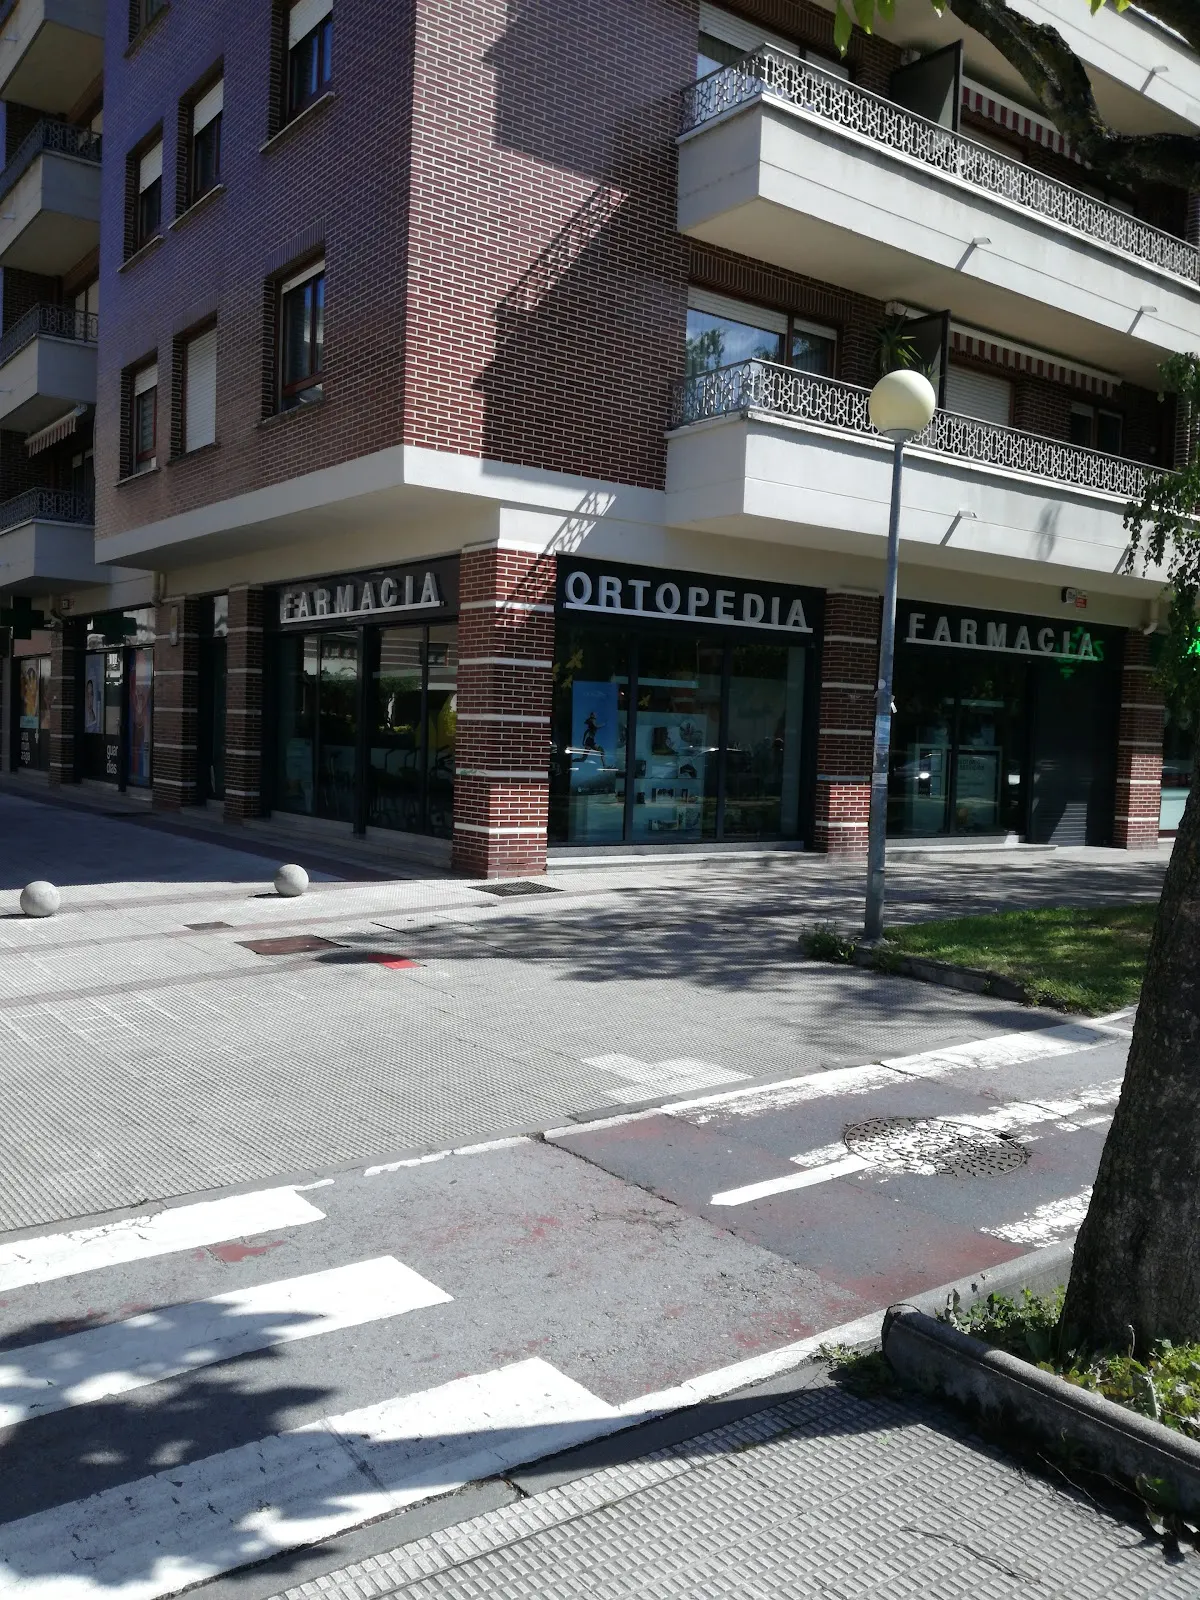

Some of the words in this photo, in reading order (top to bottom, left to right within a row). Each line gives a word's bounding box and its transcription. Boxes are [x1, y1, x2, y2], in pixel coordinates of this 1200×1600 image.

[283, 572, 440, 620] FARMACIA
[565, 571, 808, 628] ORTOPEDIA
[909, 613, 1094, 657] FARMACIA
